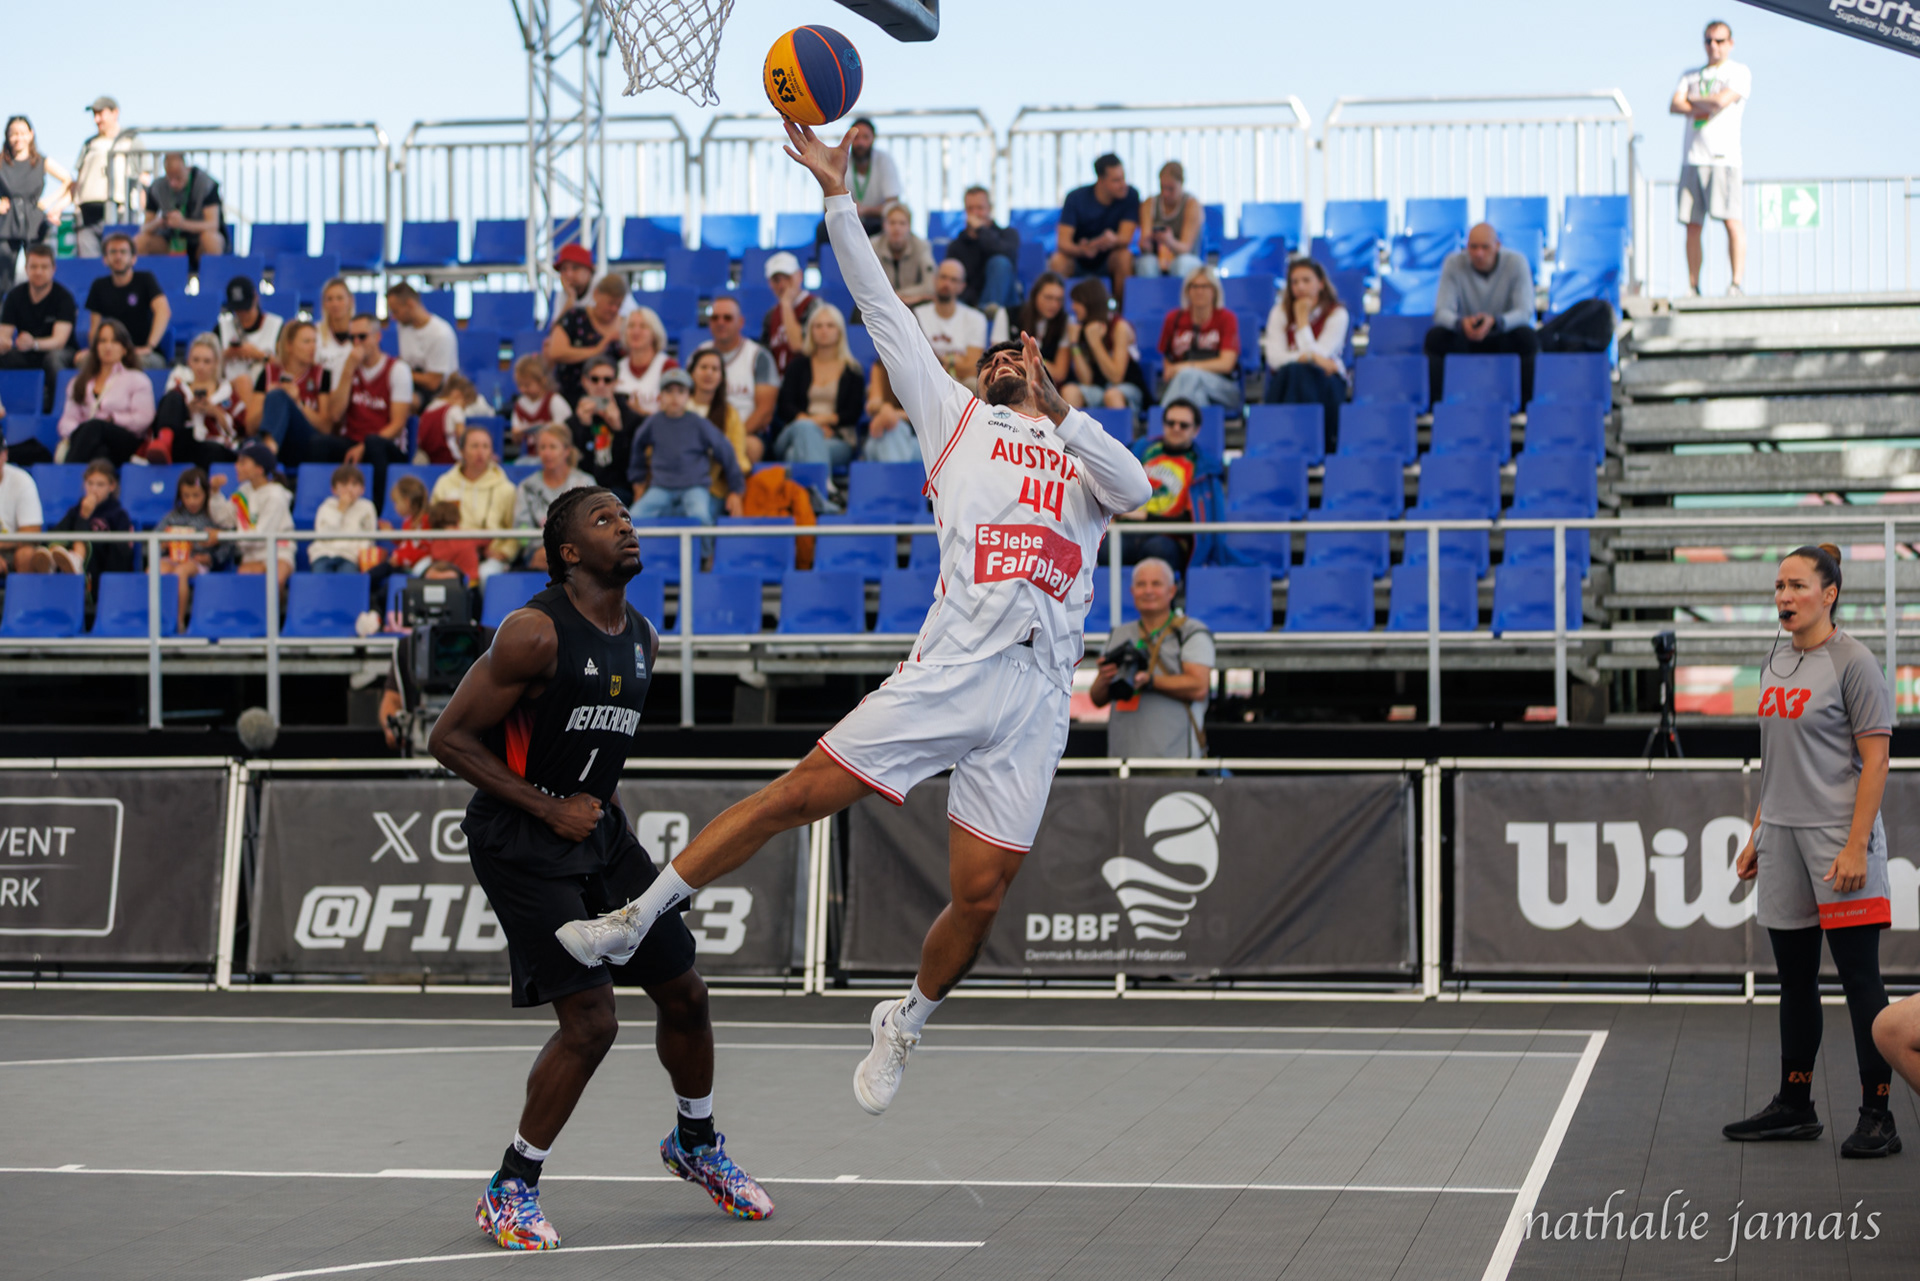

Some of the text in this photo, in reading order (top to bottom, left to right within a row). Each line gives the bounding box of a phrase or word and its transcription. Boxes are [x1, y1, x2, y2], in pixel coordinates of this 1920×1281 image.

[1835, 8, 1878, 30] Superior
[1878, 21, 1893, 36] by
[988, 420, 1013, 432] CRAFT
[990, 437, 1080, 485] AUSTRIA
[1018, 475, 1065, 523] 44
[977, 526, 1043, 550] Es lebe
[578, 748, 600, 782] 1
[1026, 913, 1120, 942] DBBF
[1025, 949, 1187, 962] Denmark Basketball Federation
